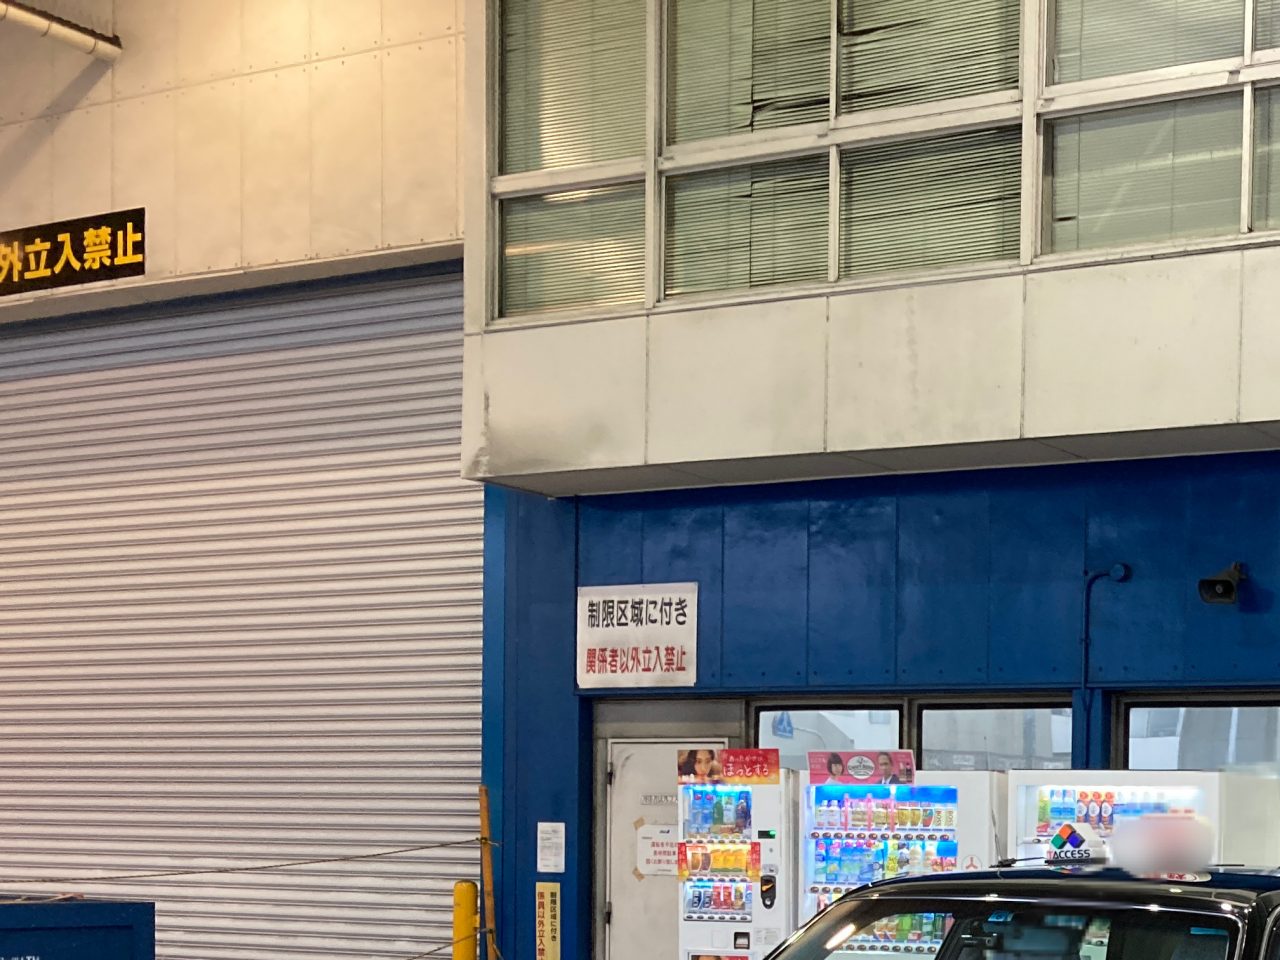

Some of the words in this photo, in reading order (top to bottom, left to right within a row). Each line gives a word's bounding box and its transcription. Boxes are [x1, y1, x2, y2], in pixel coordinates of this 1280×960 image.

[587, 597, 688, 628] 制限区域に付き
[586, 645, 686, 674] 関係者以外立入禁止
[723, 763, 769, 777] ほっとする
